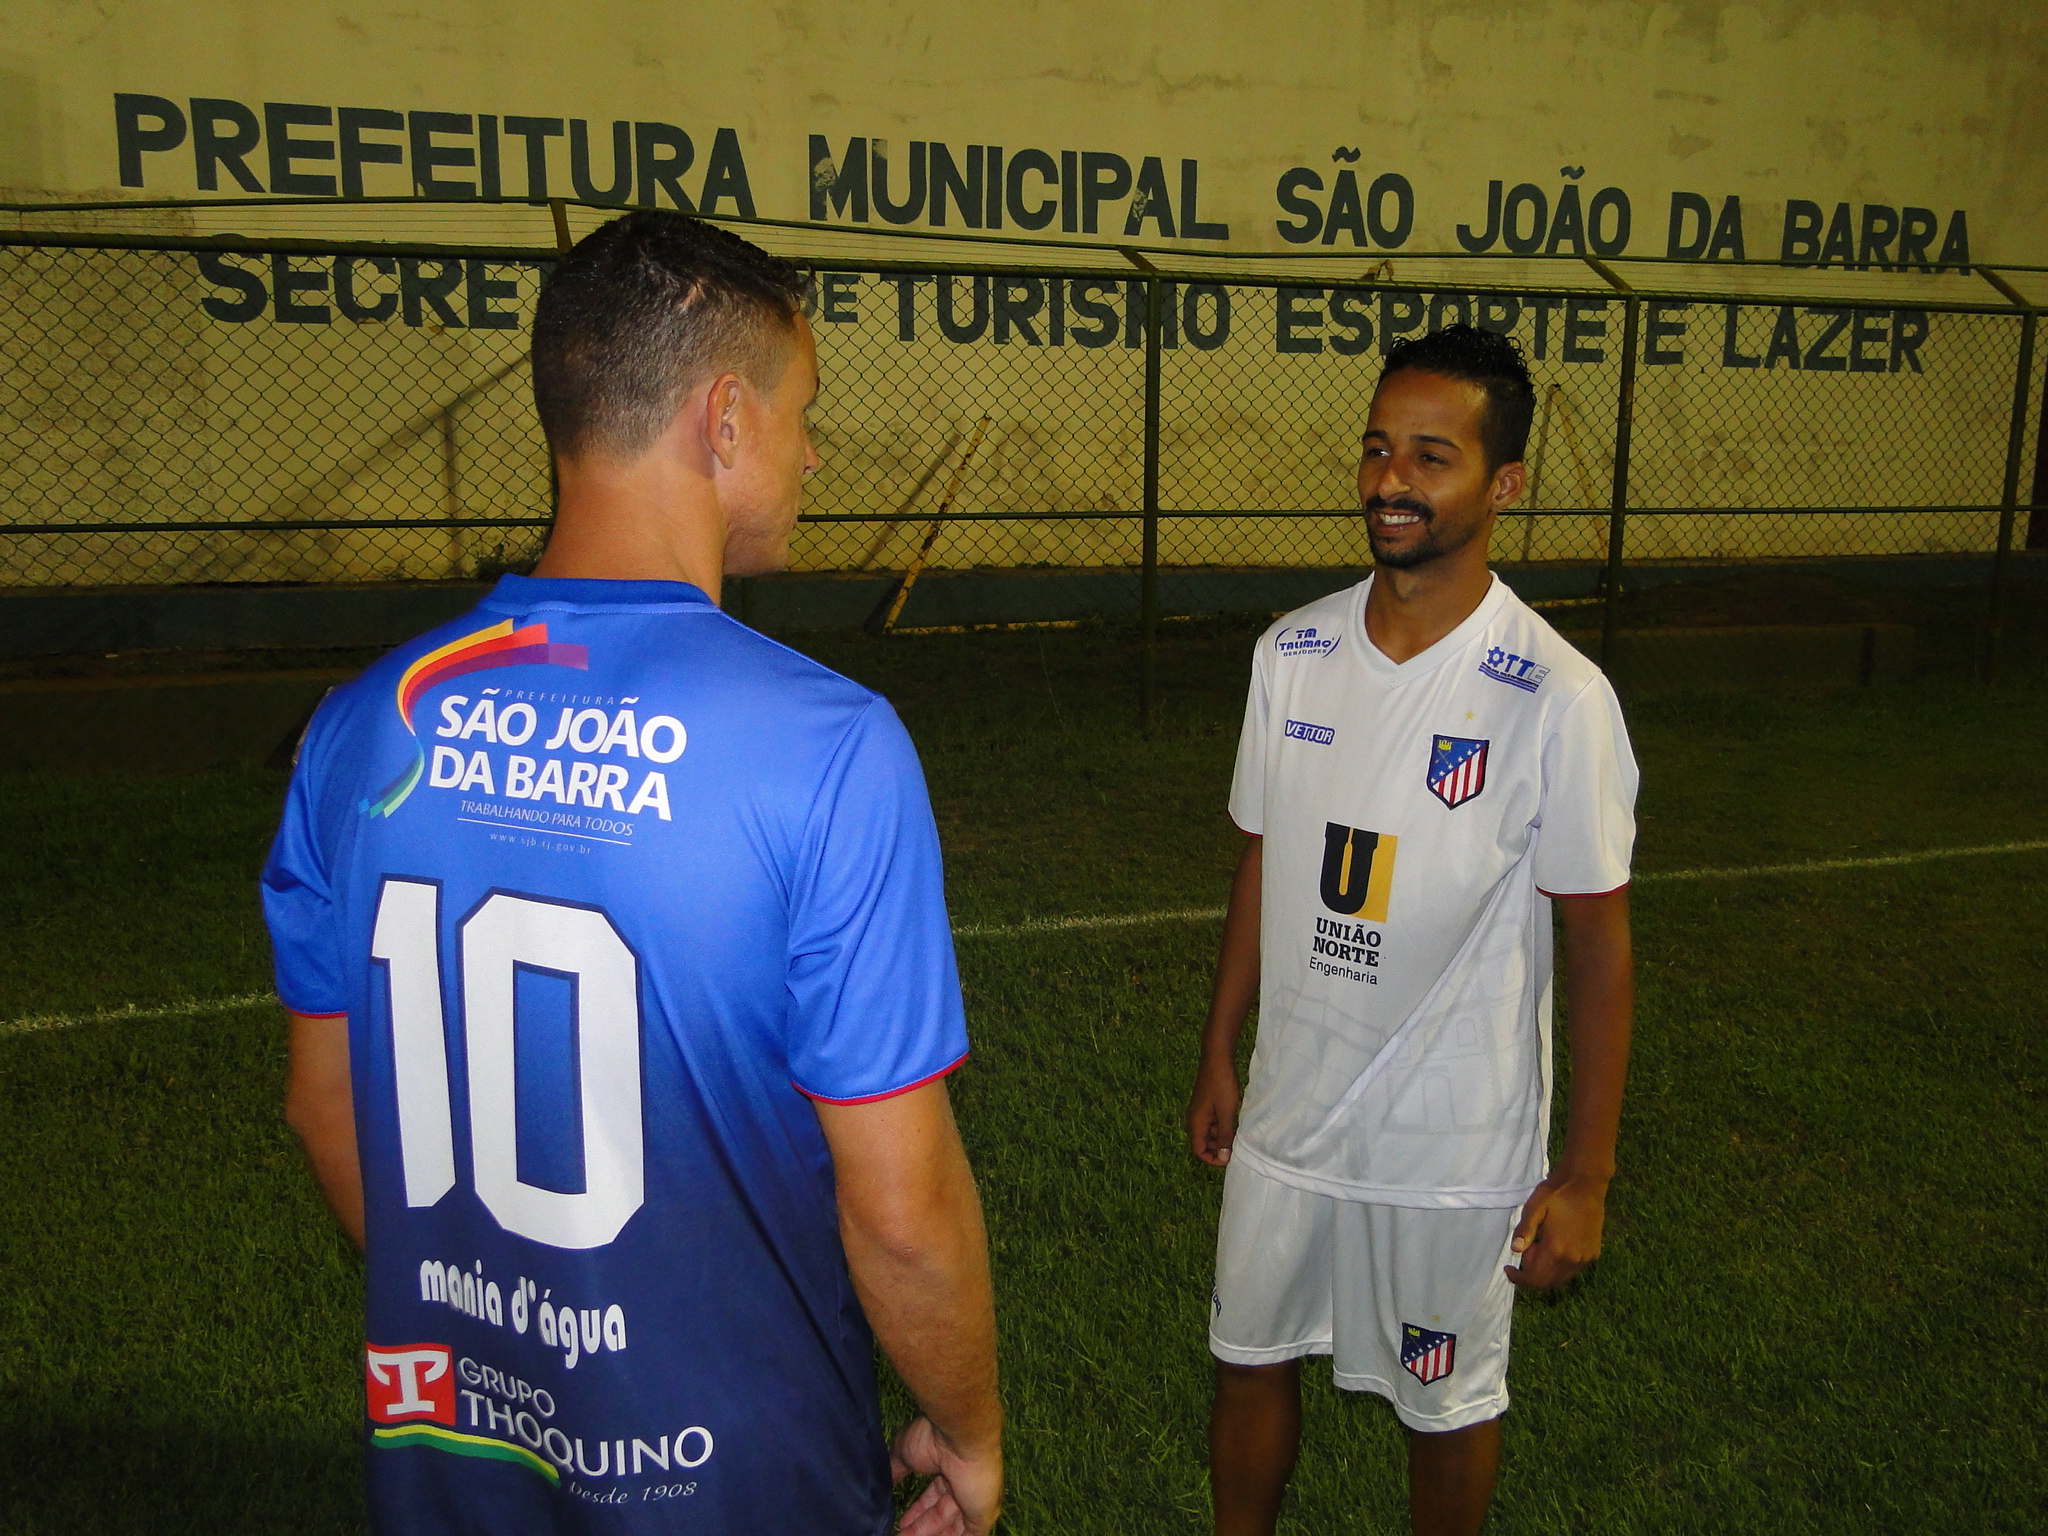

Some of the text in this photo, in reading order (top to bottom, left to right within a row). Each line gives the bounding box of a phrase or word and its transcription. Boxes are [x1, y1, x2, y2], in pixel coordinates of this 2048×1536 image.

[113, 92, 1972, 276] PREFEITURA MUNICIPAL SÃO JOÃO DA BARRA
[1643, 301, 1688, 365] E
[1722, 303, 1930, 375] LAZER
[436, 688, 688, 764] SÃO JOÃO
[504, 689, 615, 706] PREFEITURA
[1286, 721, 1334, 744] VETTOR
[429, 745, 673, 822] DA BARRA
[460, 800, 635, 837] TRABALHANDO PARA TODOS
[1312, 935, 1380, 968] NORTE
[1316, 917, 1382, 948] UNIÃO
[1309, 956, 1378, 986] Engenharia
[370, 873, 646, 1250] 10
[420, 1259, 504, 1327] mania
[459, 1357, 556, 1417] GRUPO
[460, 1388, 715, 1478] THOQUINO
[642, 1481, 698, 1501] 1908
